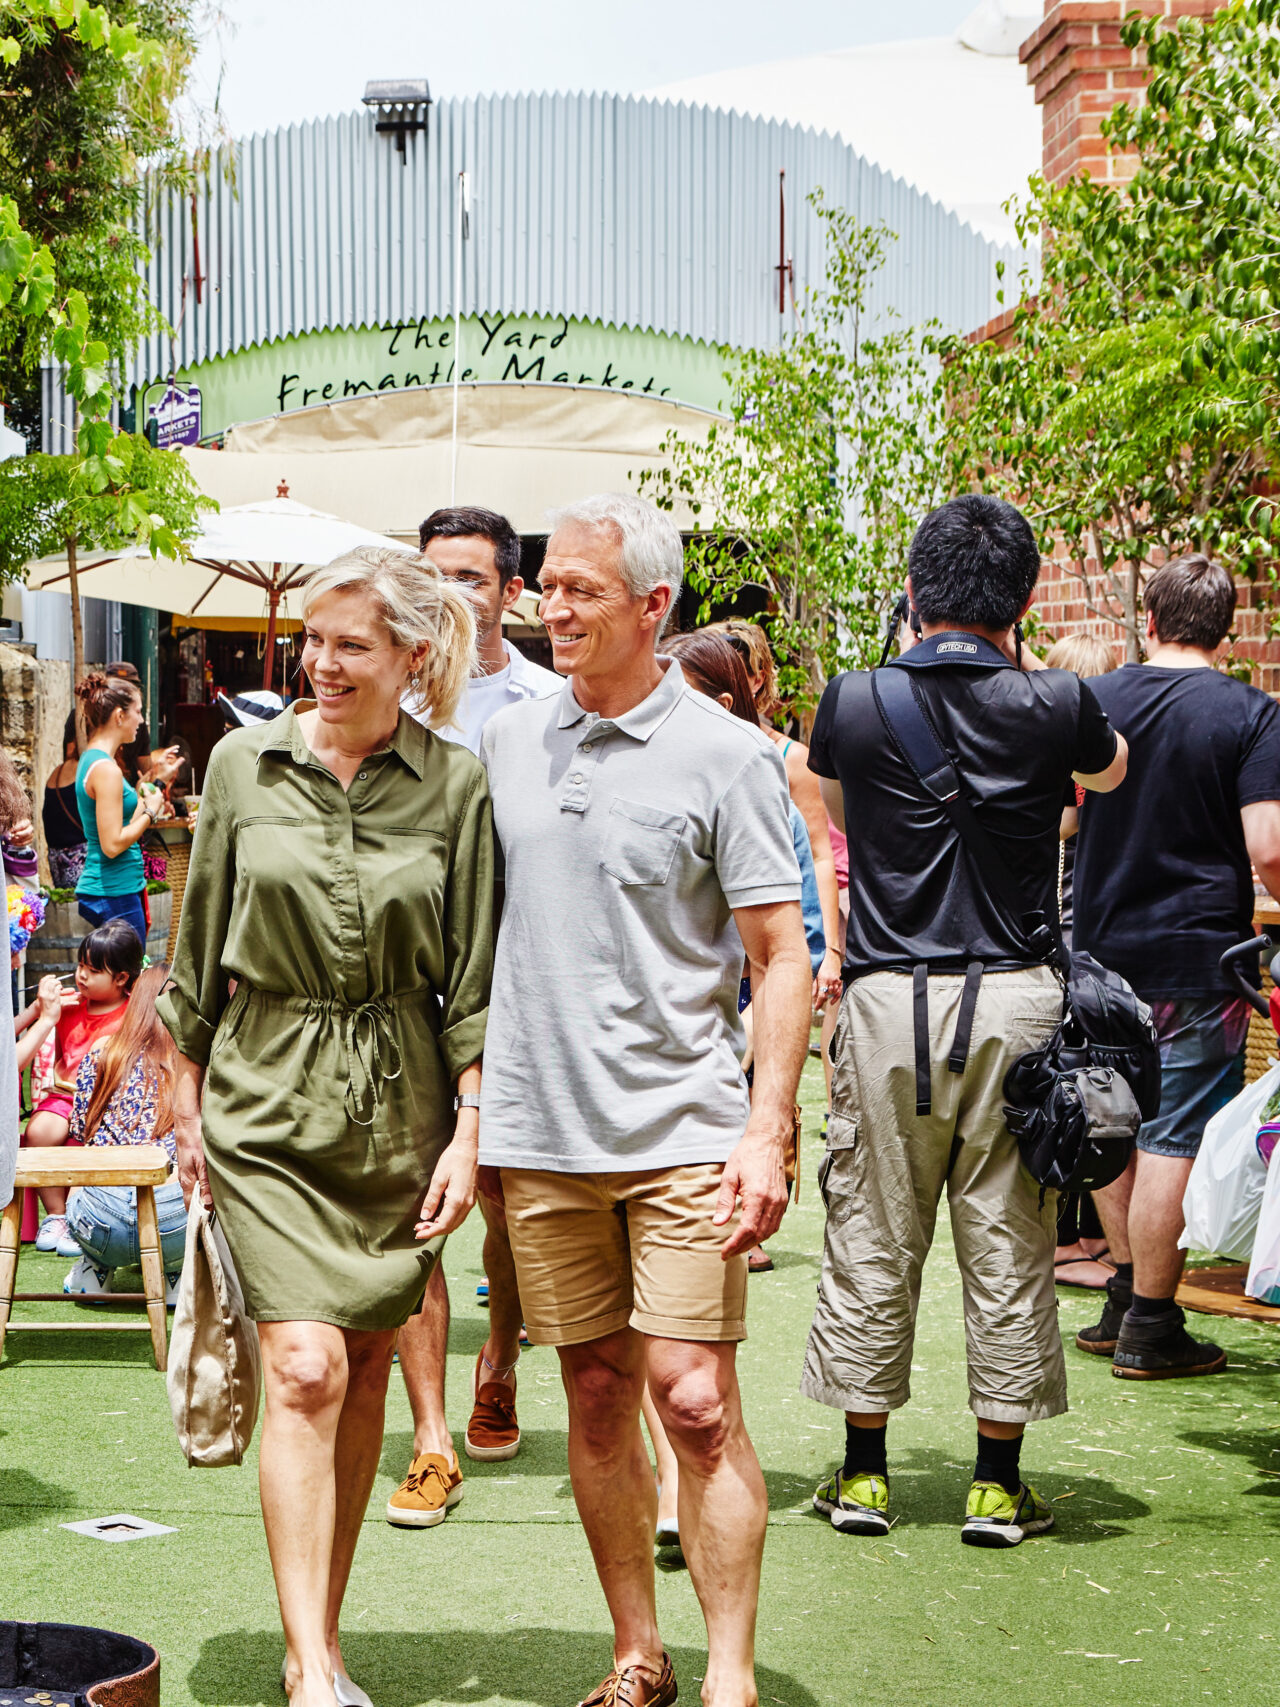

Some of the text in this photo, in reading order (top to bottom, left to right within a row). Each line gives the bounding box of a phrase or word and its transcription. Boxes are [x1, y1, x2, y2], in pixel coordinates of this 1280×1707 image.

[380, 315, 568, 356] The Yard
[277, 360, 474, 412] Fremantle
[158, 416, 196, 435] ARKETS
